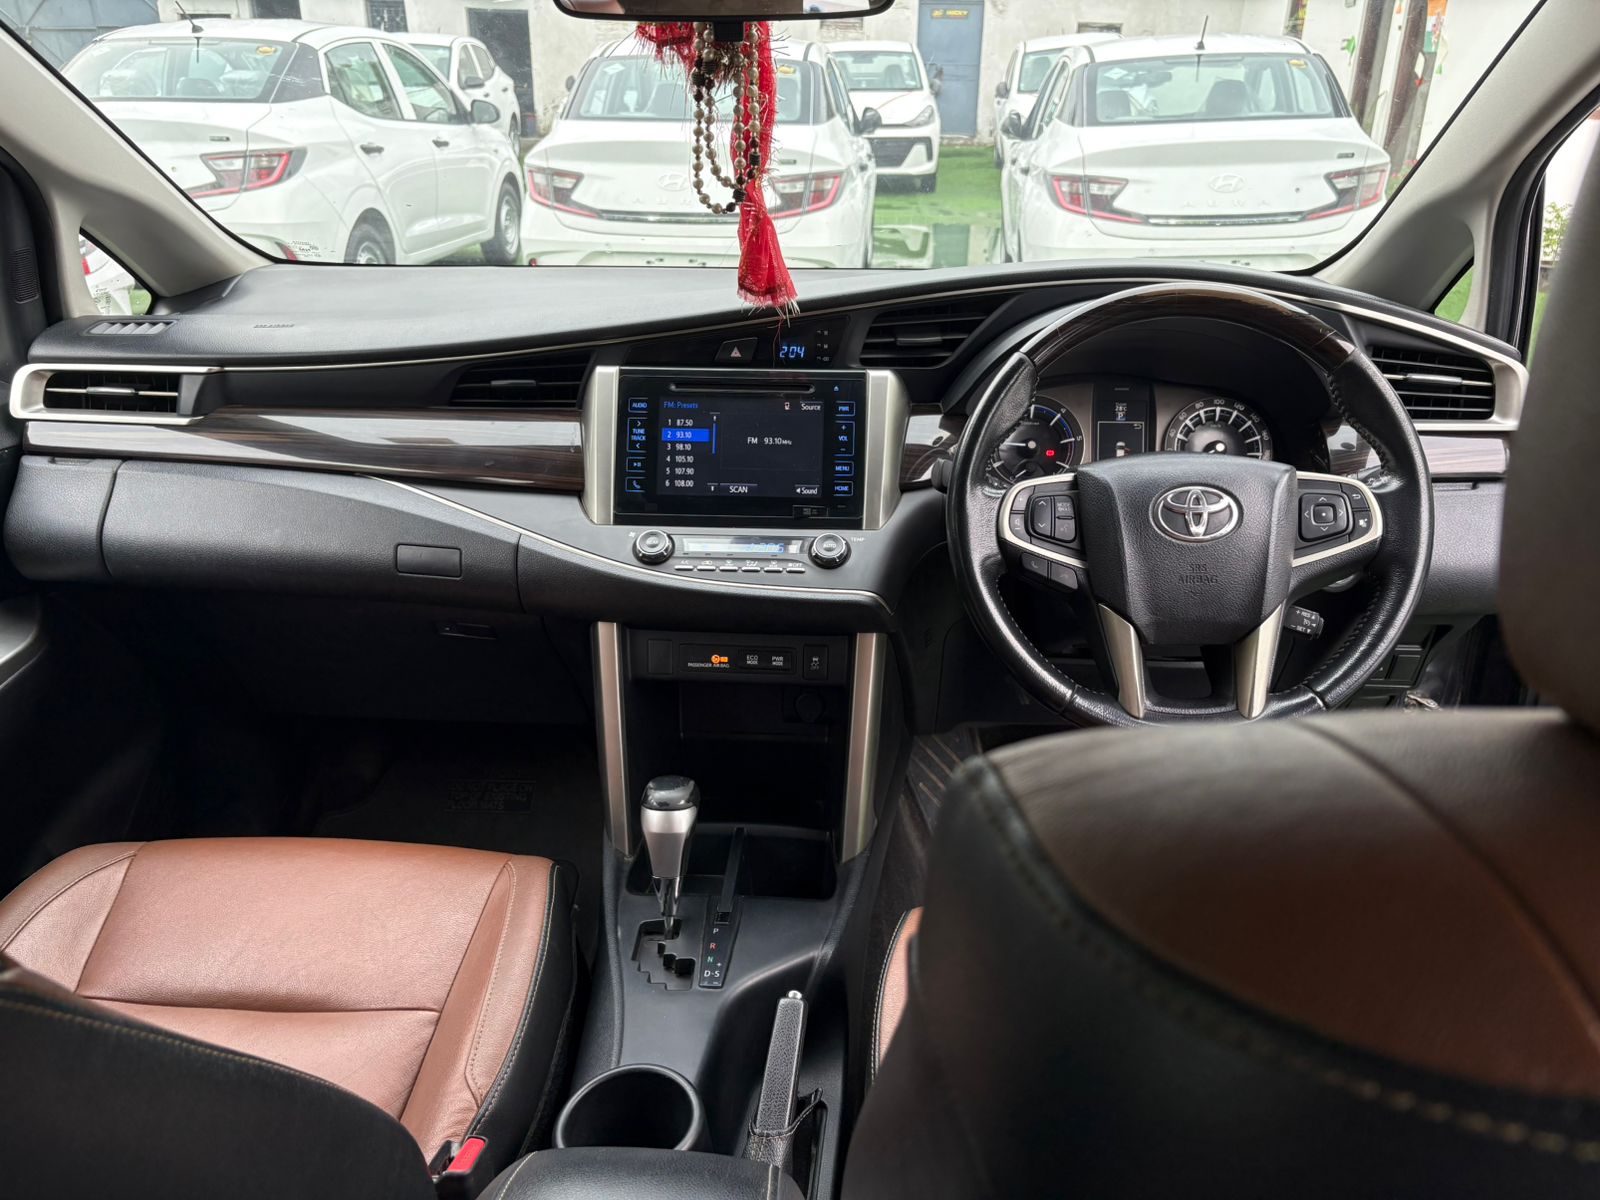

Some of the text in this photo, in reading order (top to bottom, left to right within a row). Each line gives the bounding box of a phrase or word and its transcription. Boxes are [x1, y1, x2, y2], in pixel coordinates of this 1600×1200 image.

[676, 401, 699, 409] Presets
[801, 403, 821, 411] Source
[667, 431, 692, 439] 2 93.10
[667, 443, 671, 451] 3
[666, 455, 694, 464] 4 105.10
[665, 467, 695, 475] 5 107.90
[665, 479, 695, 487] 6 108.00
[801, 486, 818, 494] Sound
